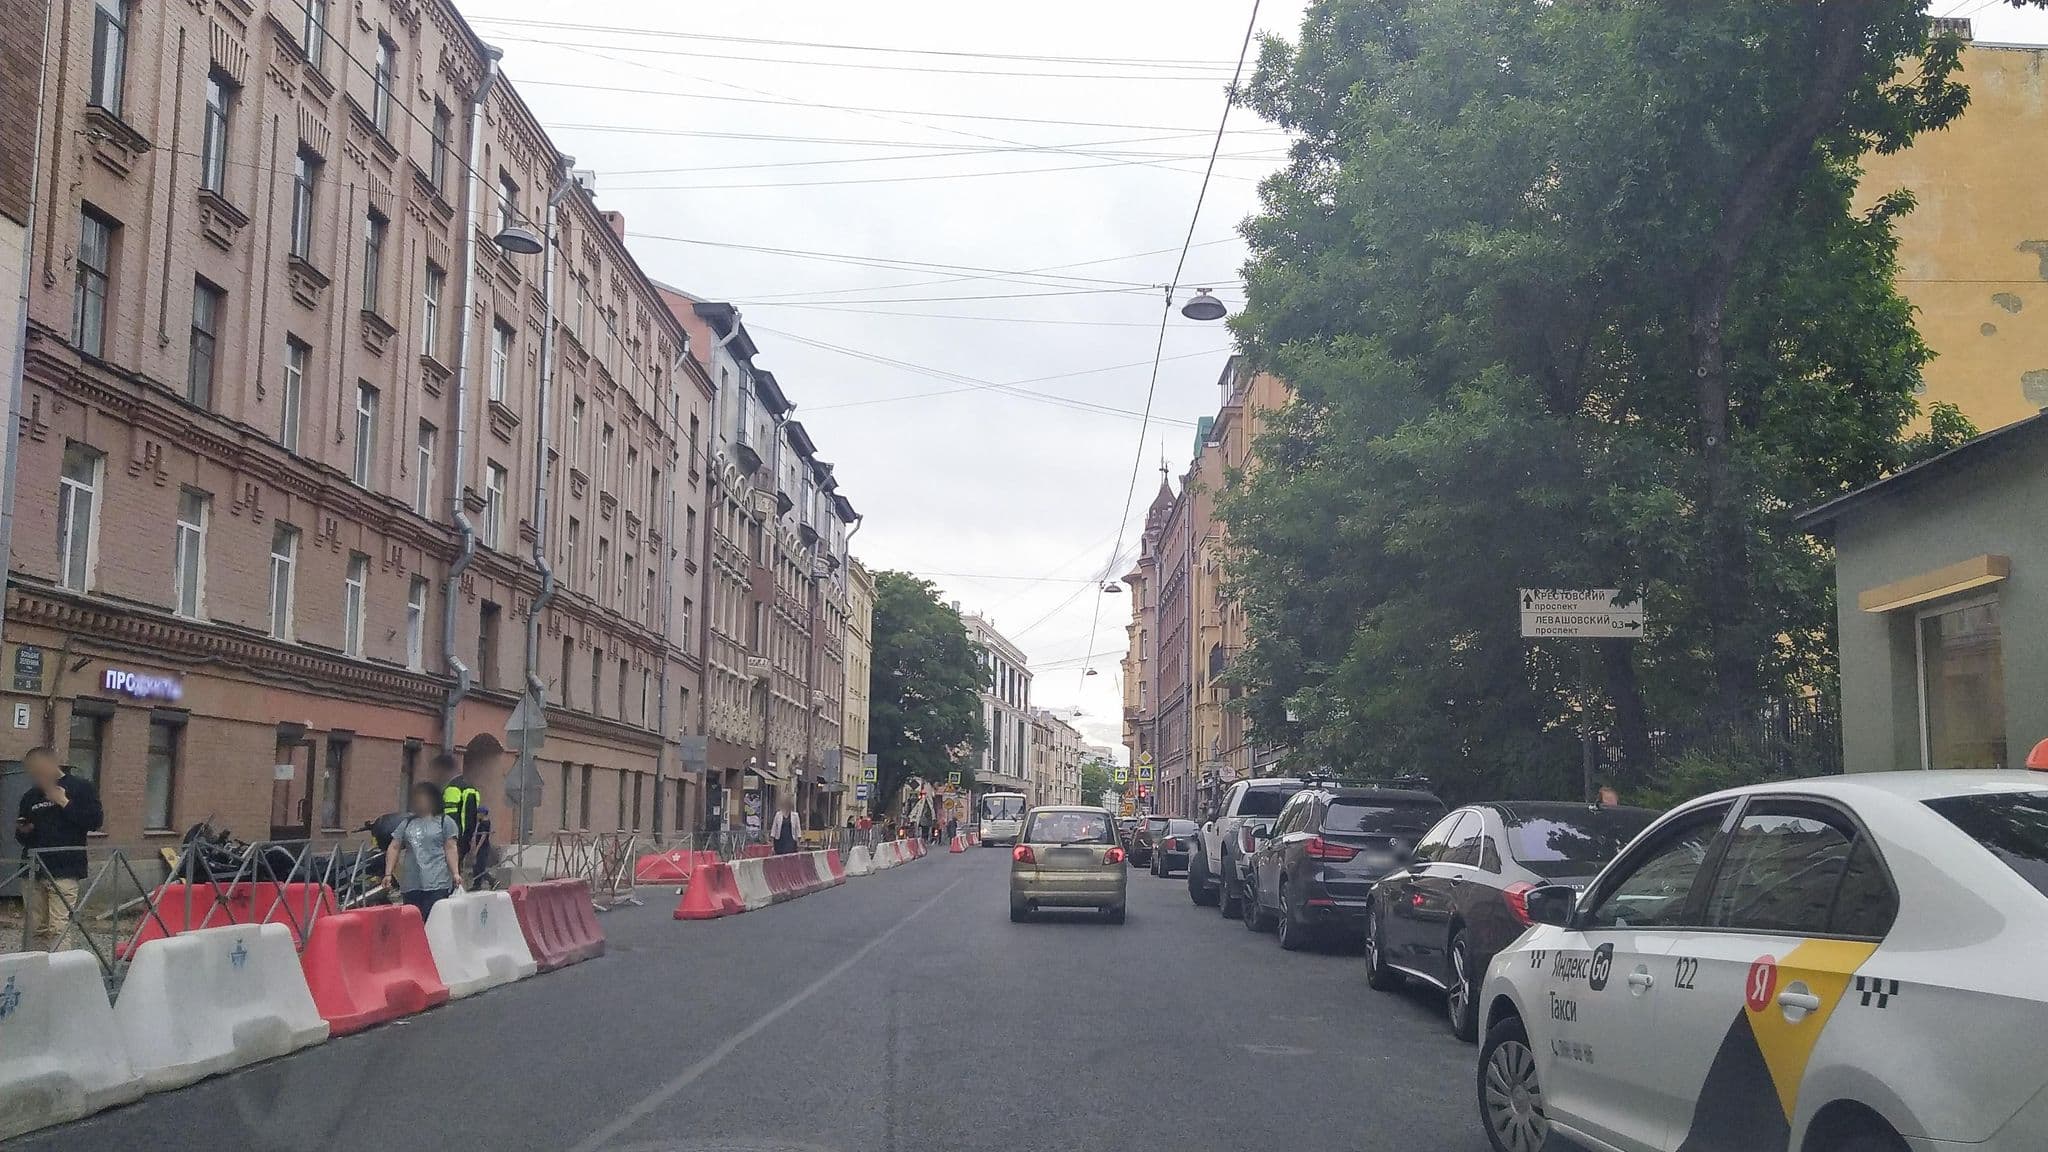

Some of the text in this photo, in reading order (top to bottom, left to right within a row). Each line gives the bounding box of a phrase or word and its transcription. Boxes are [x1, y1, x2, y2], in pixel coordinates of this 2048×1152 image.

[1534, 590, 1605, 600] КРЕСТОВСКИЙ
[1535, 614, 1610, 624] ЛЕВАШОВСКИЙ
[1535, 627, 1578, 635] проспект
[1552, 950, 1609, 981] Яндекс Go
[1674, 956, 1698, 989] 122
[1751, 964, 1770, 1001] Я
[1550, 991, 1577, 1022] Такси
